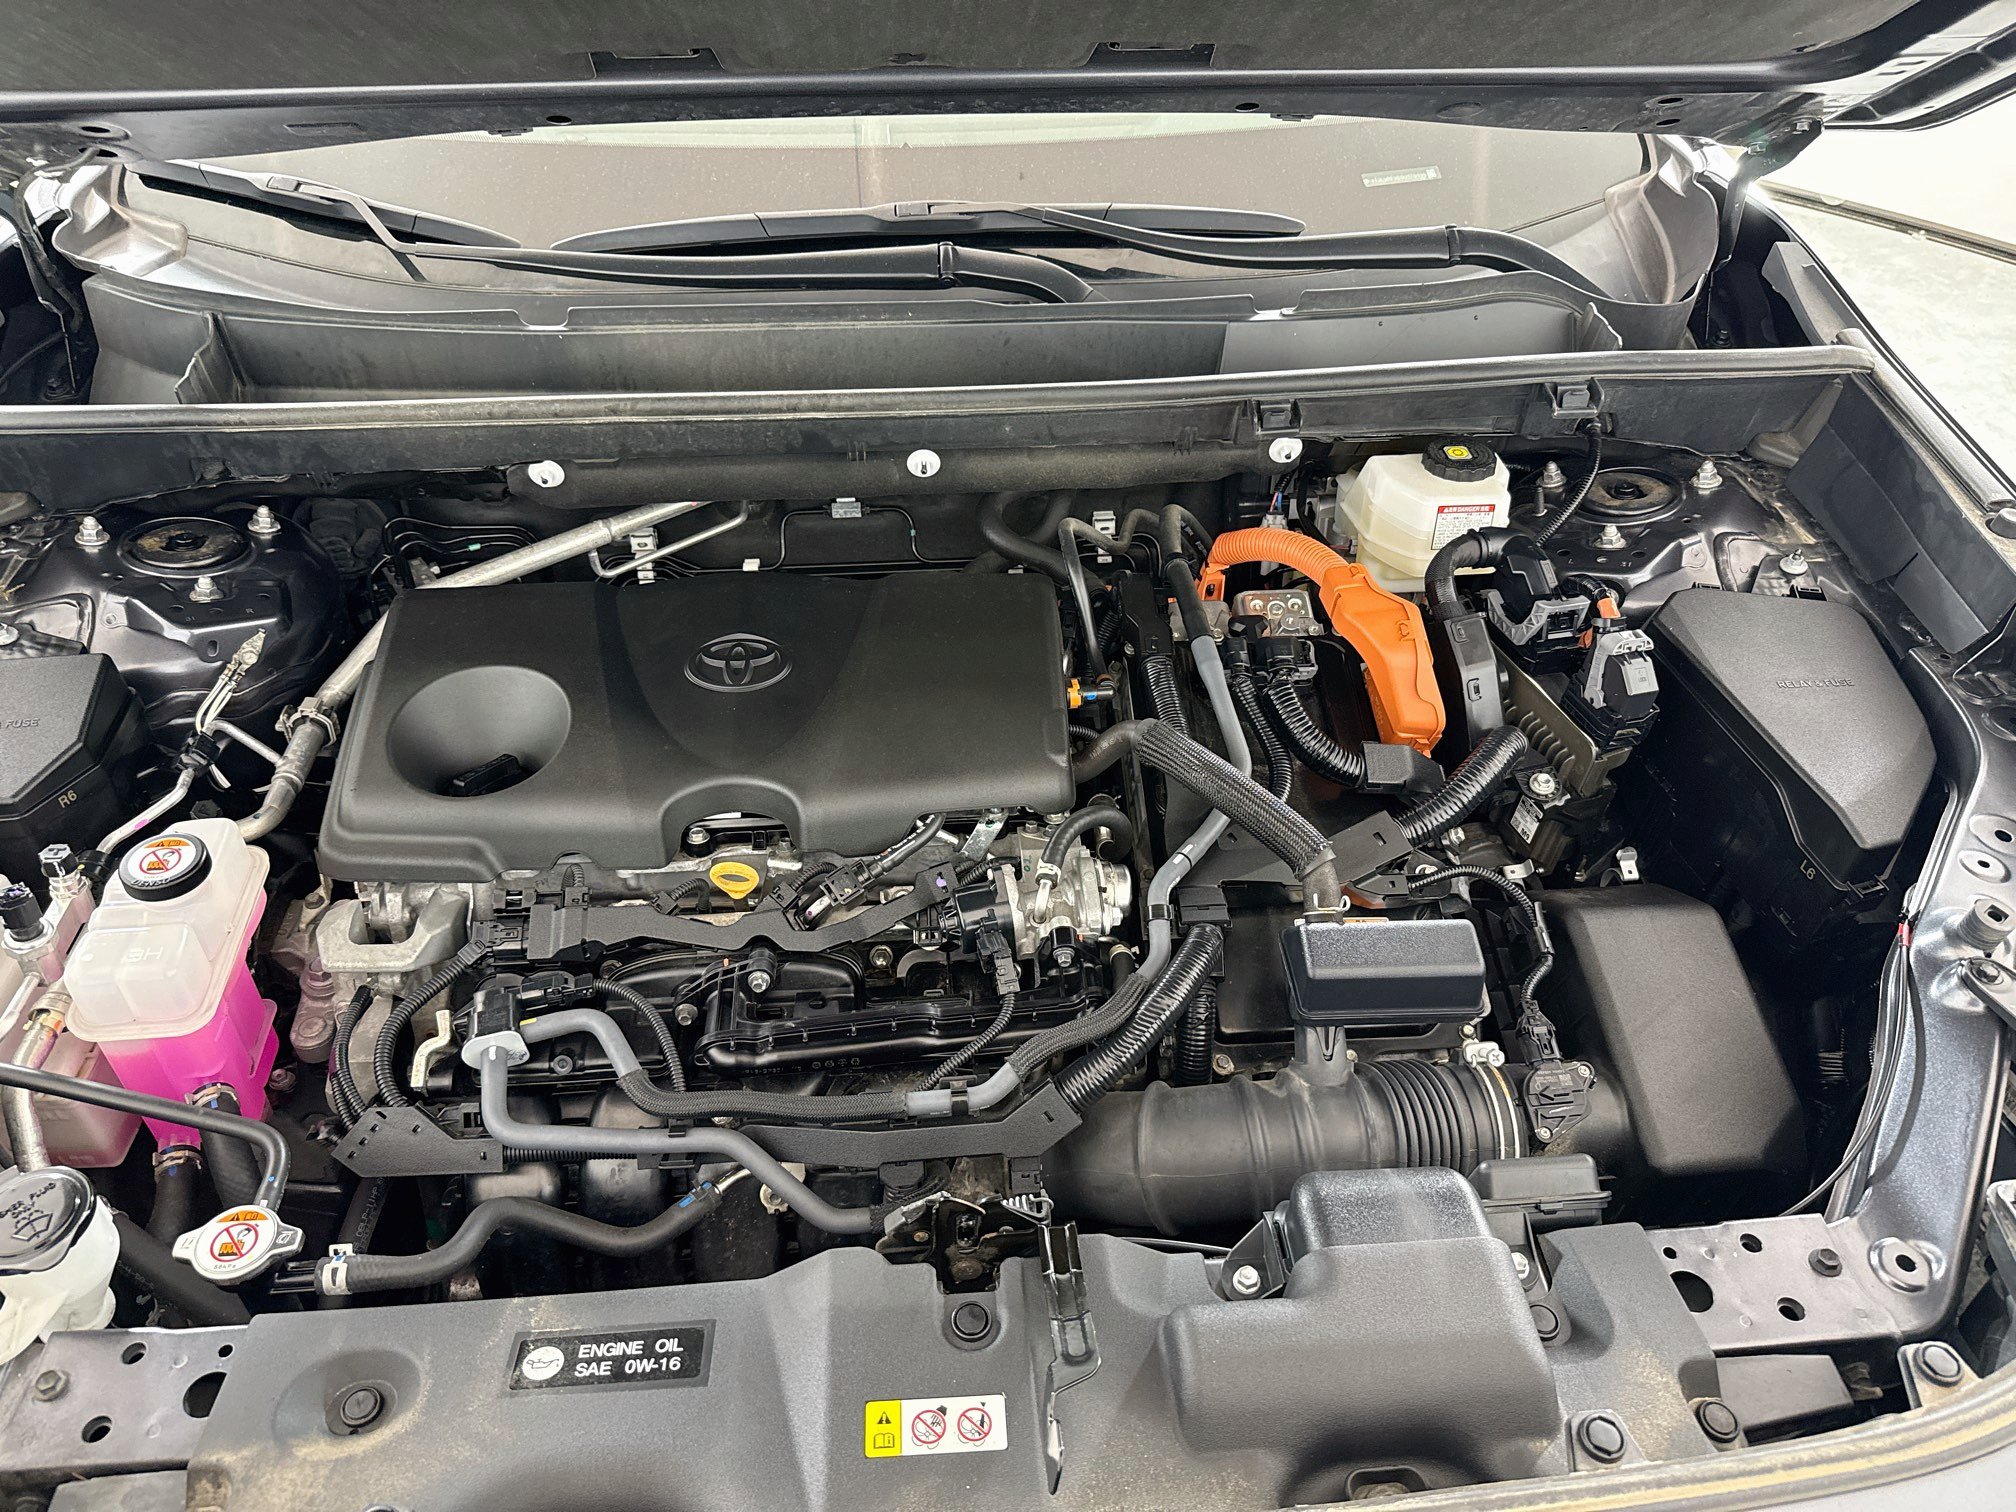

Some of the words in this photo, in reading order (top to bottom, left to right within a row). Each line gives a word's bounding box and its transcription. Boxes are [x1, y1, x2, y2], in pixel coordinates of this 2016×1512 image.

[1776, 680, 1813, 689] RELAY
[1814, 679, 1824, 688] &
[1823, 678, 1855, 687] FUSE
[5, 717, 40, 729] FUSE
[57, 789, 79, 809] R6
[1799, 859, 1817, 880] L6
[130, 877, 171, 888] DENSO
[577, 1340, 645, 1359] ENGINE
[654, 1337, 684, 1354] OIL
[574, 1360, 613, 1378] SAE
[624, 1356, 682, 1375] 0W-16
